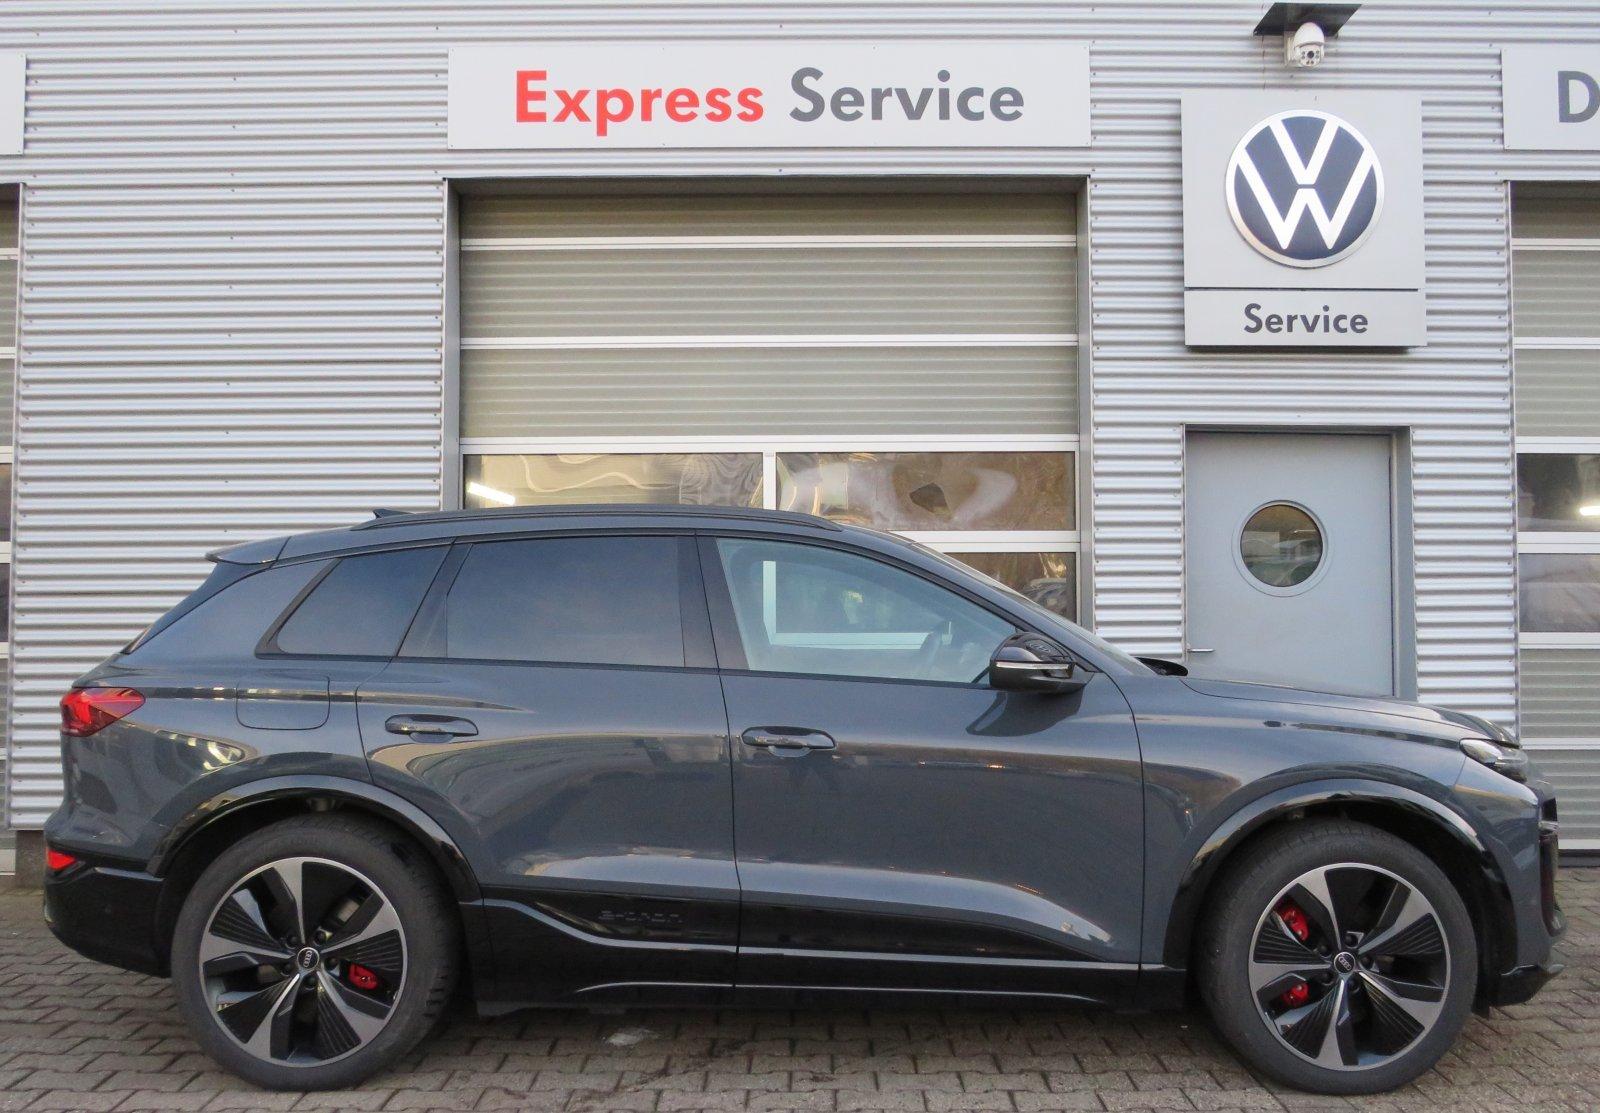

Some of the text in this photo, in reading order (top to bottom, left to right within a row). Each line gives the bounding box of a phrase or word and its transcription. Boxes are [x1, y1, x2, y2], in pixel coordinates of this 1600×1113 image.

[515, 66, 1025, 137] Express Service
[1243, 302, 1369, 334] Service
